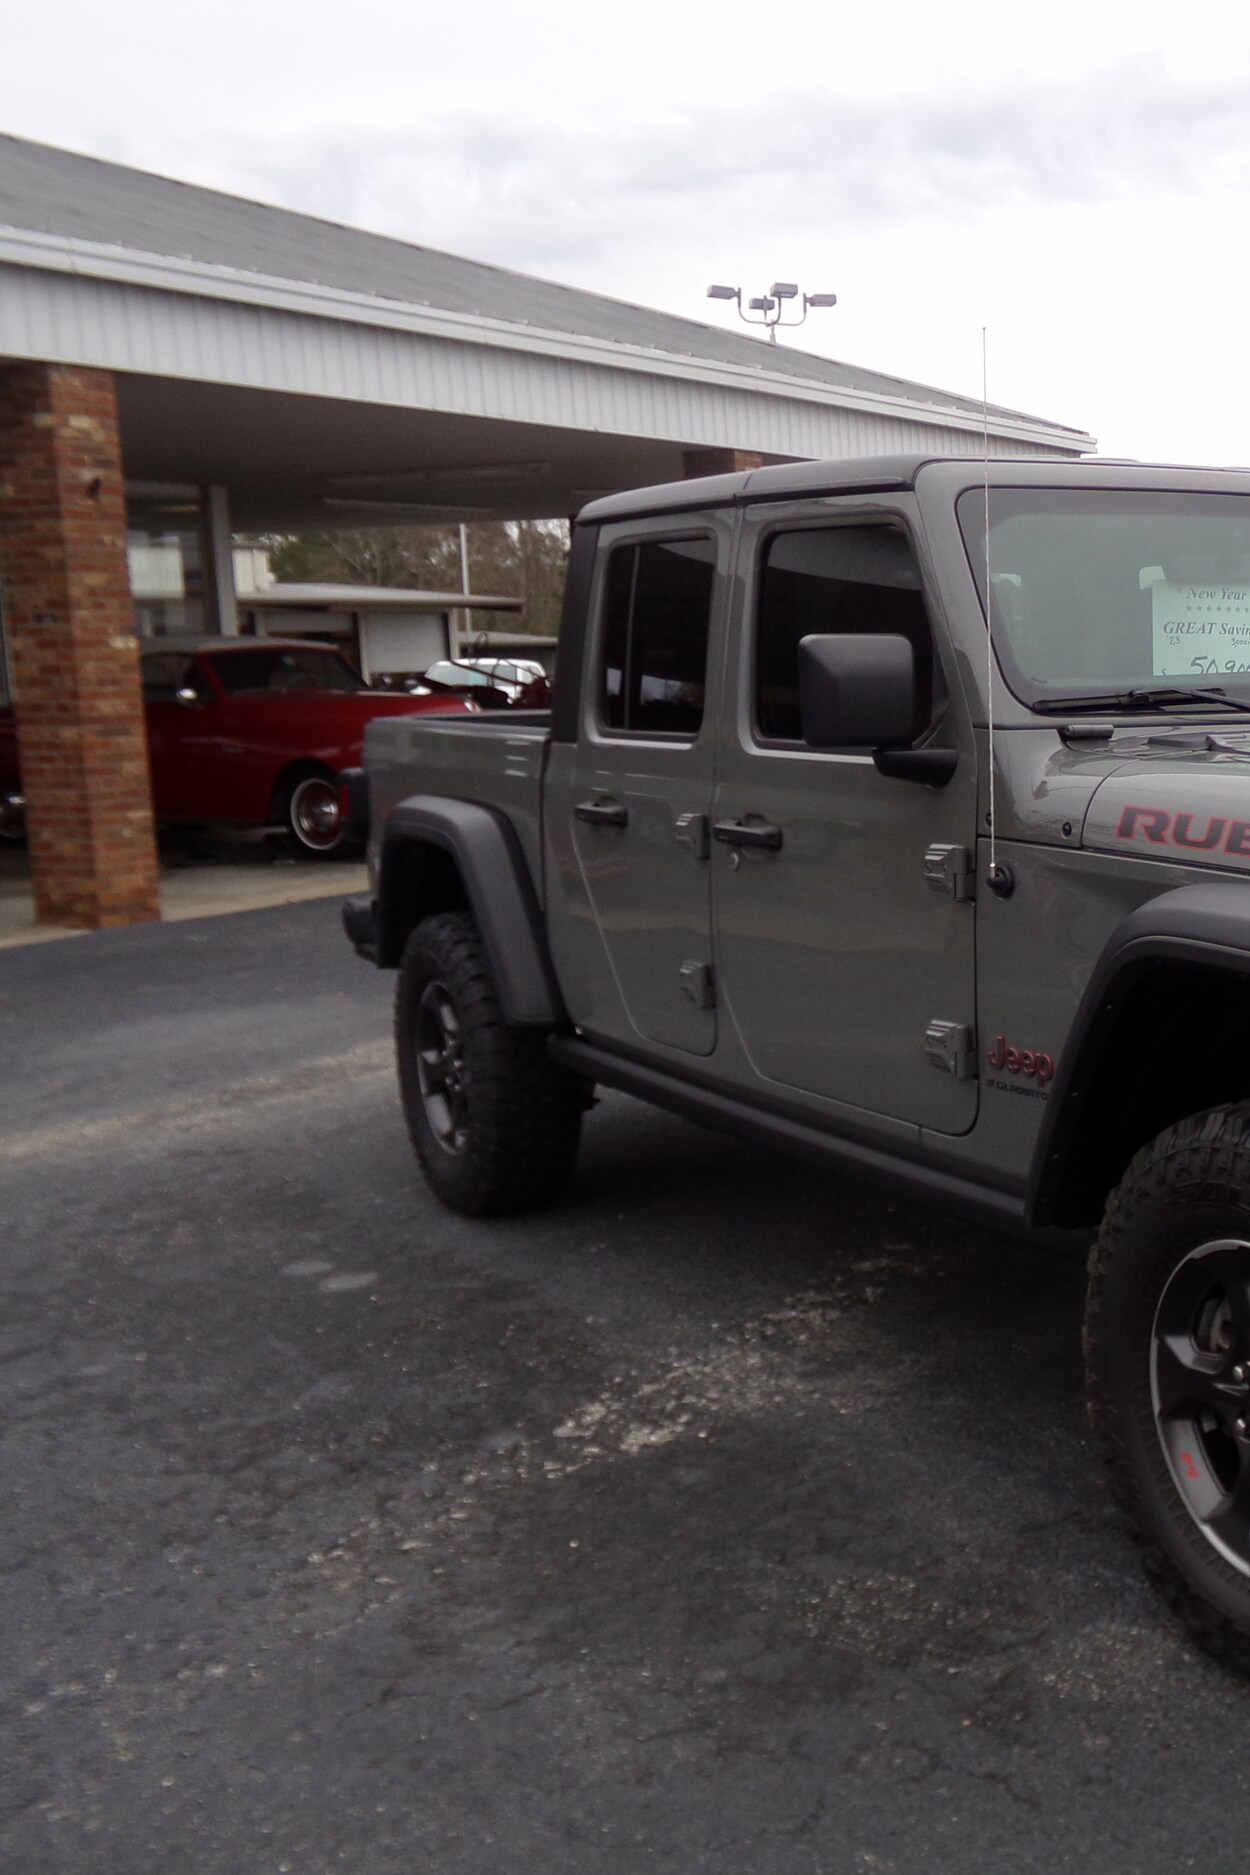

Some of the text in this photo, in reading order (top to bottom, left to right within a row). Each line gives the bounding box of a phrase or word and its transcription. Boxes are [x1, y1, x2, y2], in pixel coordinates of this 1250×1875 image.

[1186, 587, 1247, 601] New Year
[1163, 621, 1217, 635] GREAT
[986, 1034, 1056, 1088] Jeep
